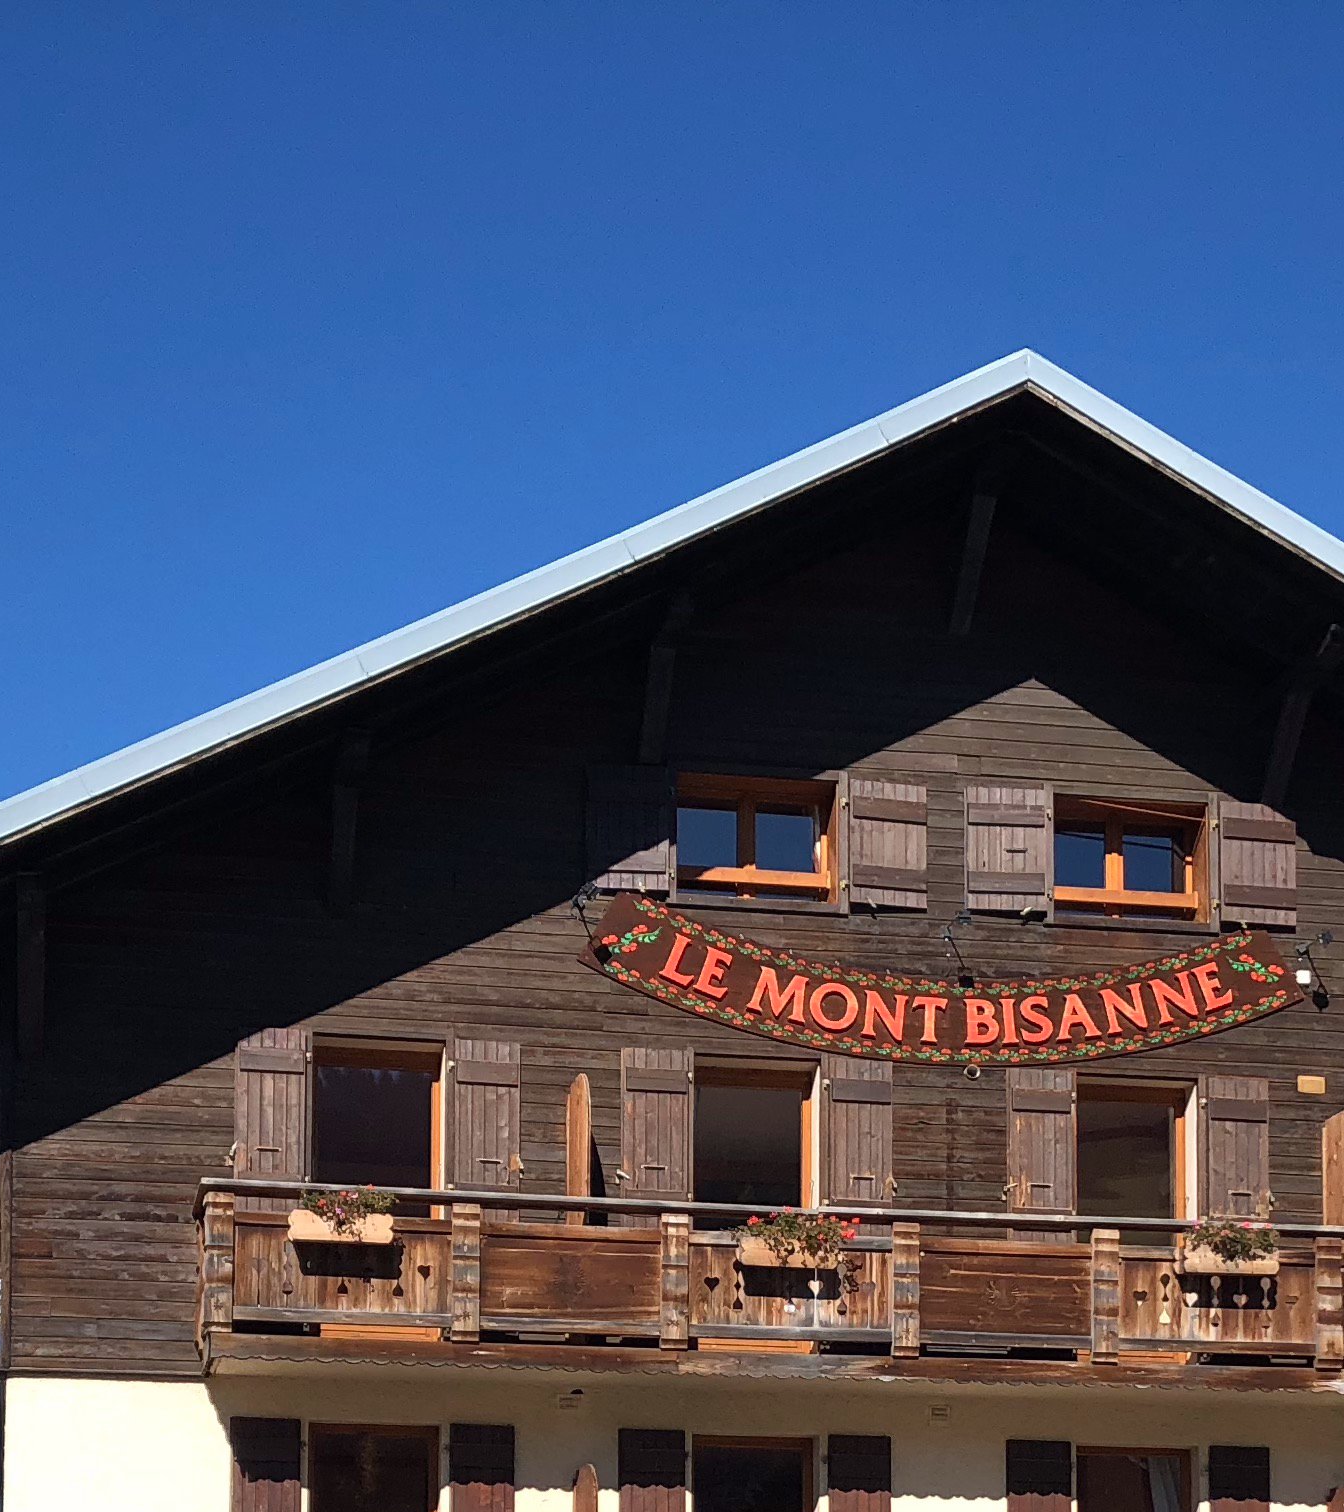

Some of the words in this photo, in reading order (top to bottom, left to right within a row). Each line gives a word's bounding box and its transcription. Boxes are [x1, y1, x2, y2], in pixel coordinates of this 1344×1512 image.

[658, 932, 733, 998] LE
[746, 965, 949, 1045] MONT
[963, 961, 1234, 1046] BISANNE
